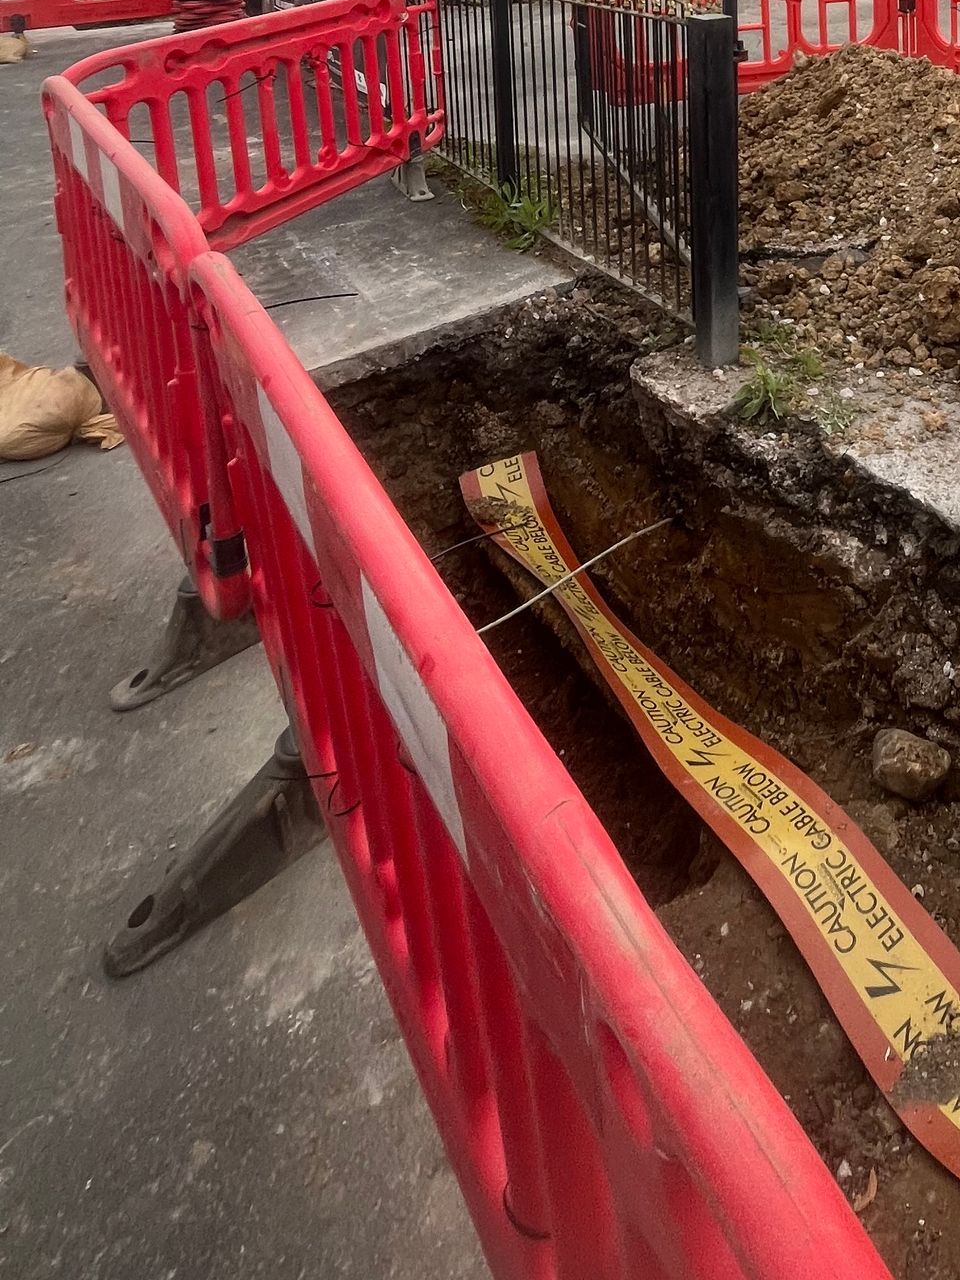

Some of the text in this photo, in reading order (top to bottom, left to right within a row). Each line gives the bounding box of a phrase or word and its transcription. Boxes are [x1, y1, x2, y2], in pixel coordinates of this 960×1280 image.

[537, 544, 567, 574] CABLE
[585, 624, 684, 745] CAUTION CAUTION
[605, 631, 723, 748] ELECTRIC CABLE BELOW
[732, 762, 789, 806] BELOW
[779, 800, 832, 850] CABLE
[703, 776, 857, 954] CAUTION CAUTION
[825, 850, 905, 952] ELECTRIC
